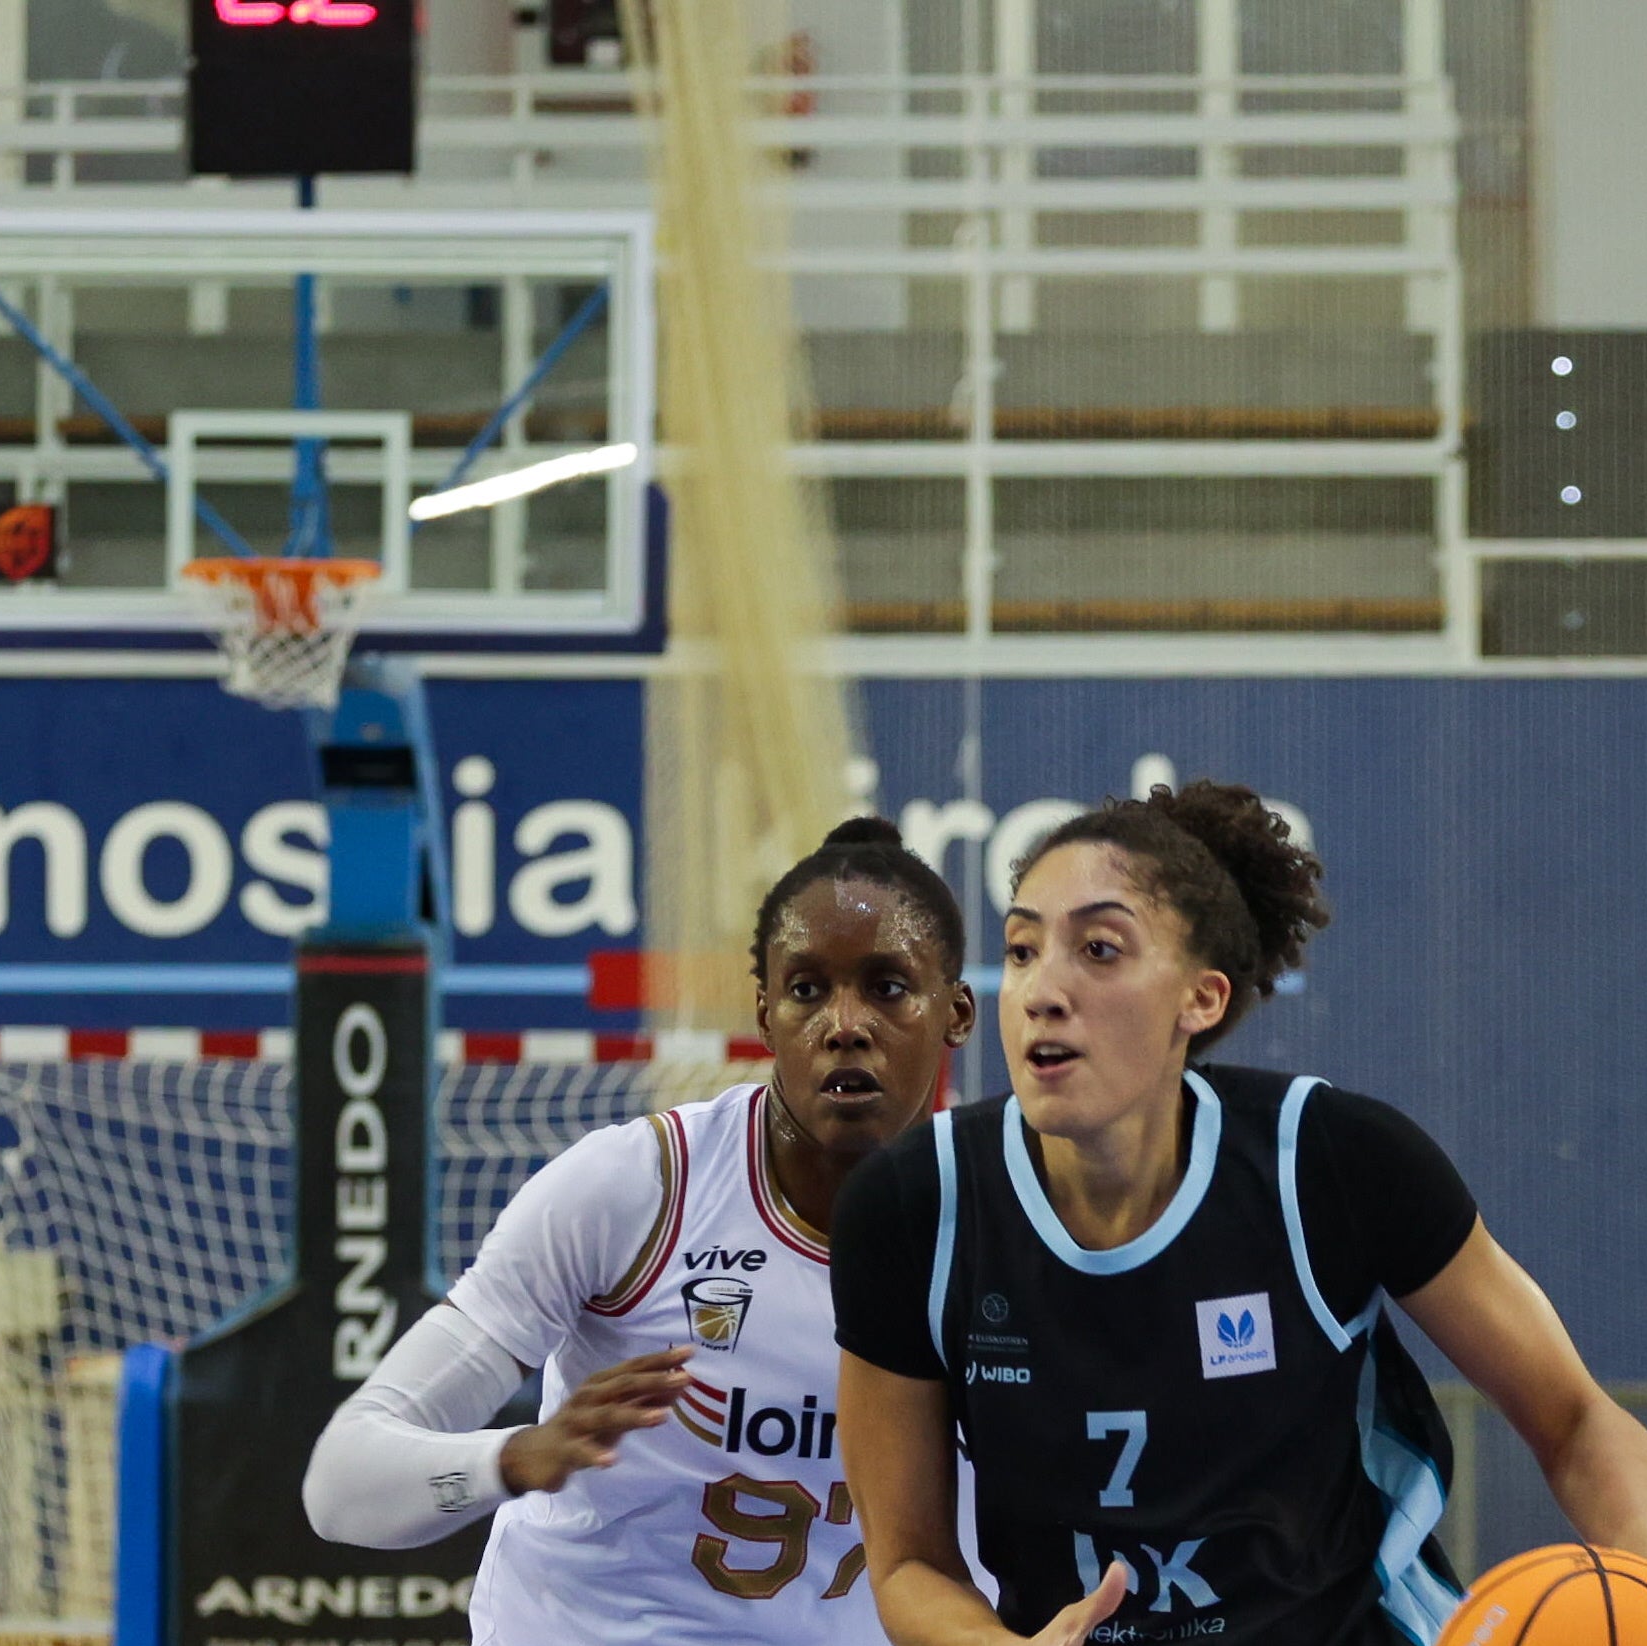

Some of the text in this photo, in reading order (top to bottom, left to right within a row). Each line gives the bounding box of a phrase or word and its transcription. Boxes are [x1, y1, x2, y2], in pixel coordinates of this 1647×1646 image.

[332, 1002, 397, 1380] RNEDO
[682, 1245, 767, 1272] vive
[981, 1365, 1031, 1384] WIBO
[1086, 1410, 1148, 1507] 7
